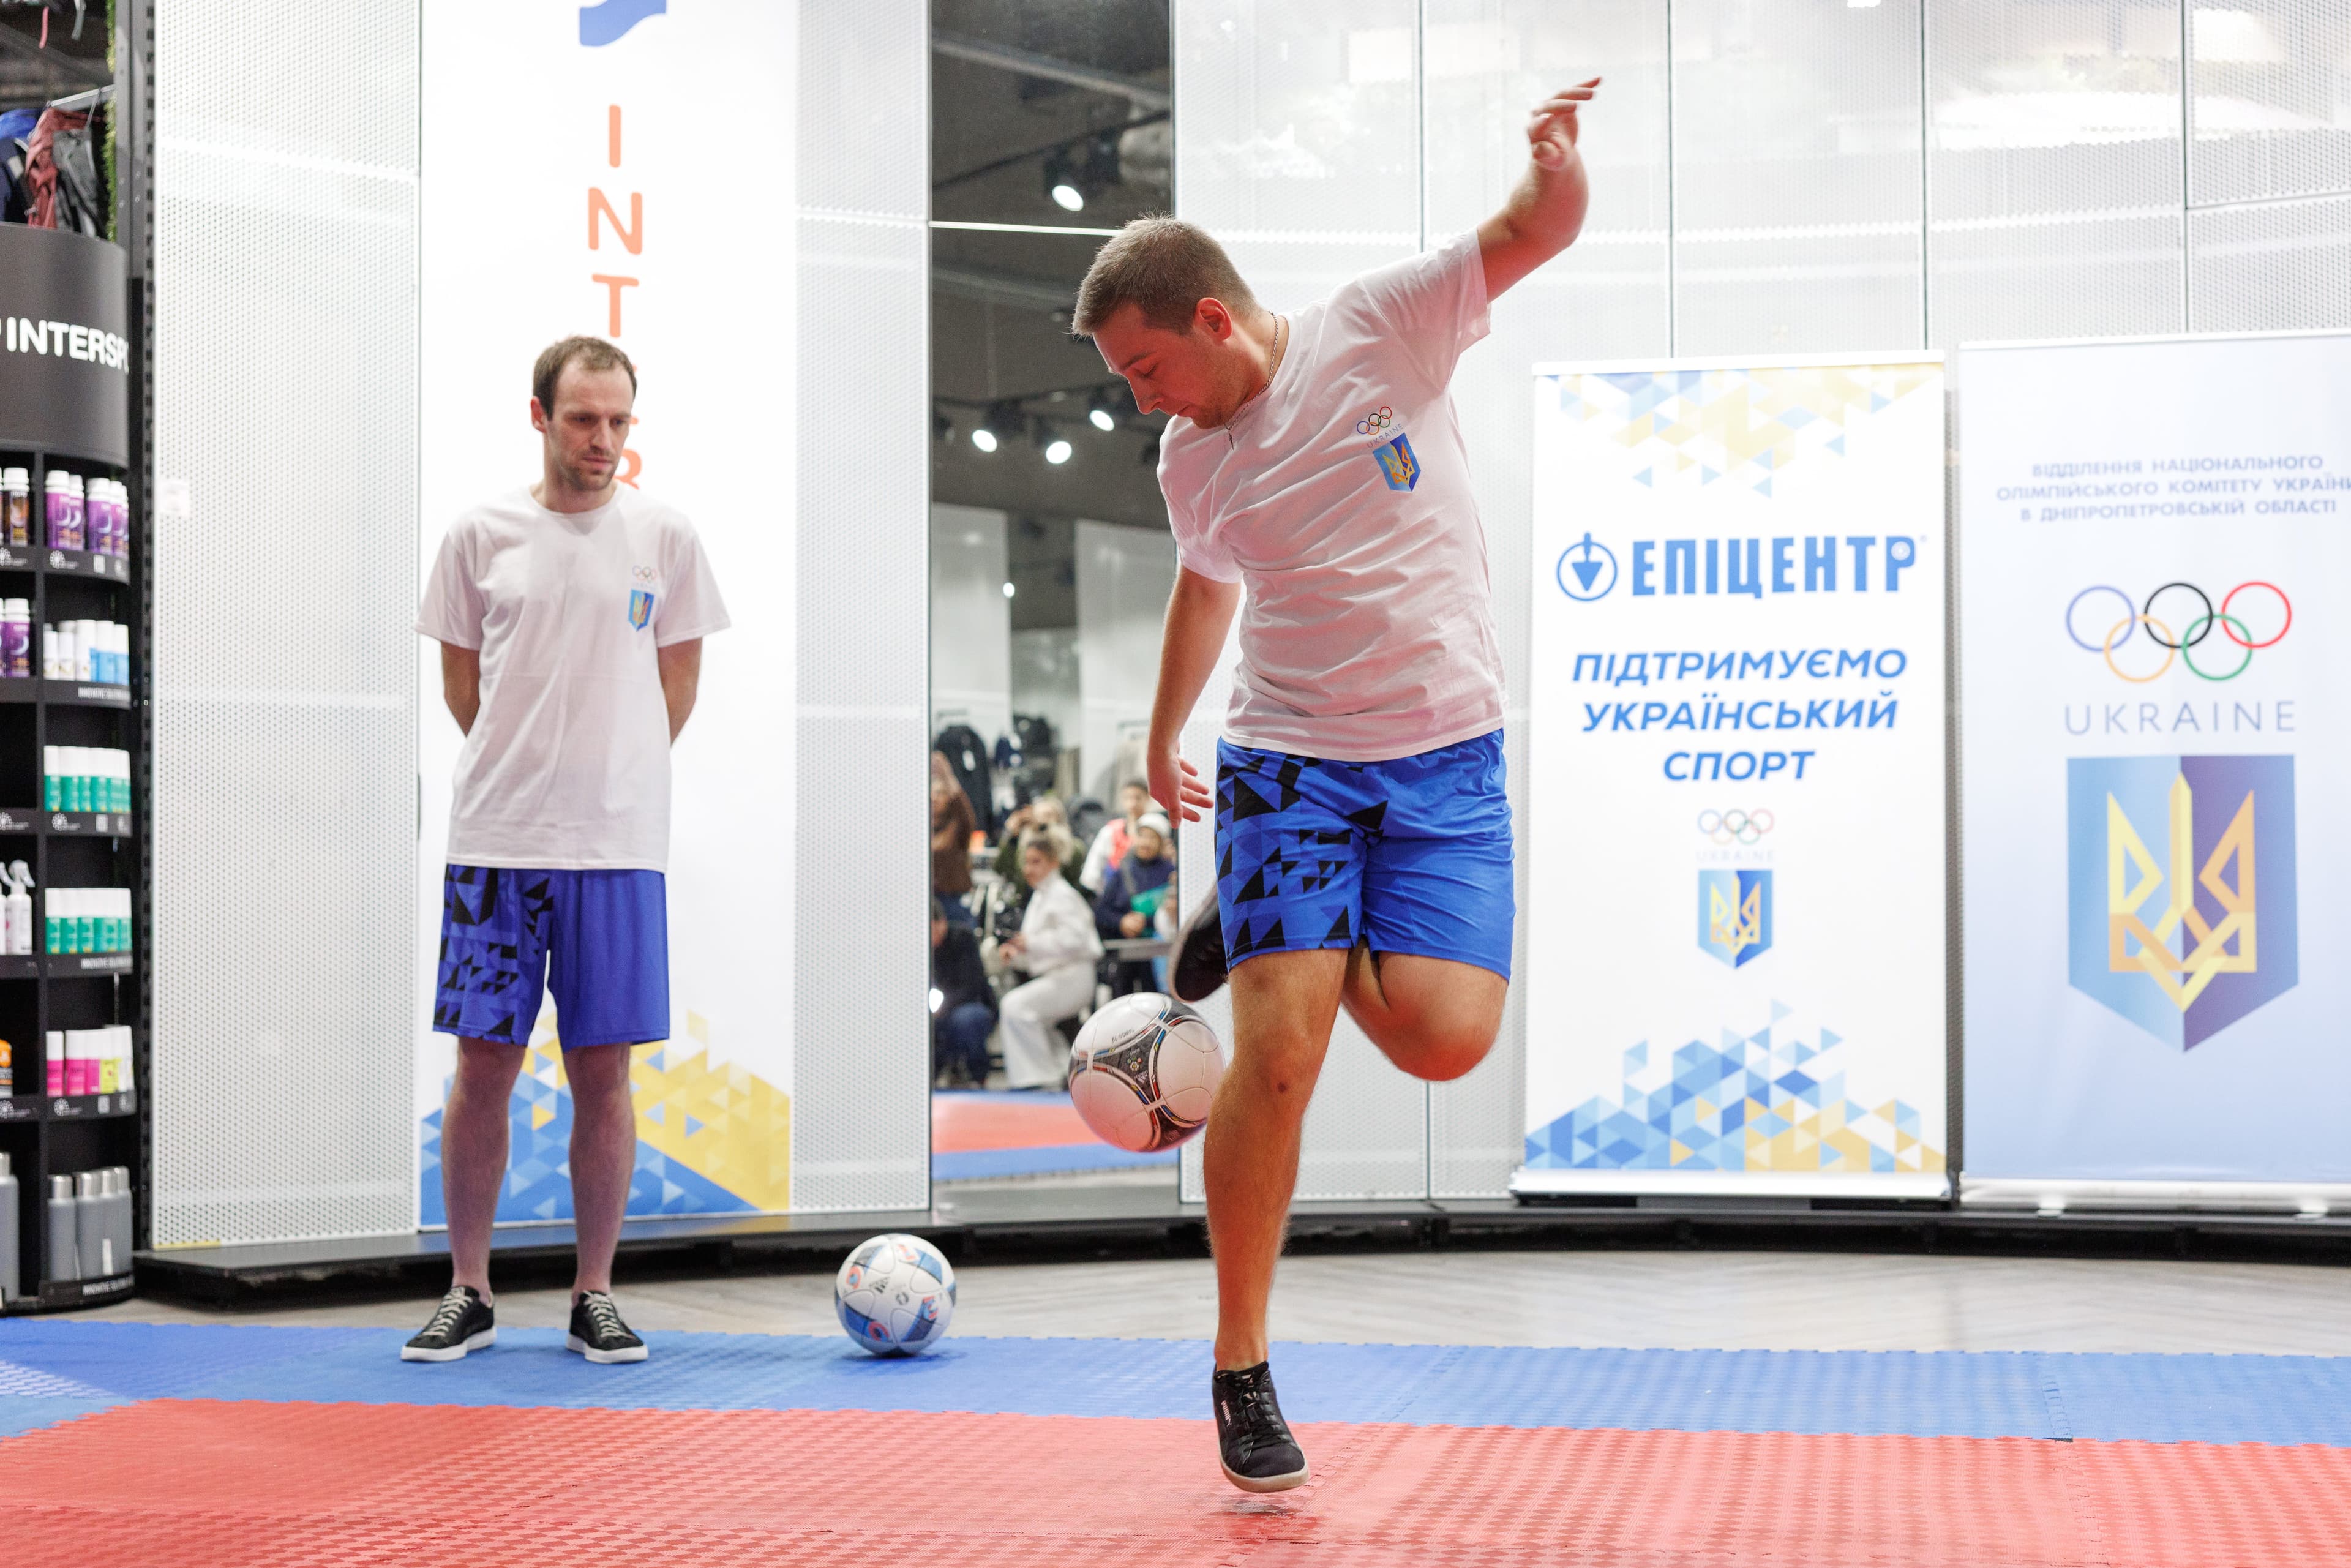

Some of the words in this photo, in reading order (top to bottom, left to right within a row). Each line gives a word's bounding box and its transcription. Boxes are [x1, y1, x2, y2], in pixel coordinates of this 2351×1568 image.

[1367, 423, 1404, 448] UKRAINE
[2031, 460, 2143, 479] ВІДДІЛЕННЯ
[2152, 455, 2323, 473] НАЦІОНАЛЬНОГО
[1997, 481, 2159, 501] ОЛІМПІЙСЬКОГО
[2169, 479, 2263, 493] КОМІТЕТУ
[2020, 508, 2031, 522] В
[2040, 498, 2245, 522] ДНІПРОПЕТРОВСЬКІЙ
[2255, 499, 2338, 515] ОБЛАСТІ
[1632, 536, 1916, 599] ЕПІЦЕНТР
[1572, 650, 1907, 687] ПІДТРИМУЄМО
[1582, 691, 1899, 732] УКРАЇНСЬКИЙ
[2064, 700, 2296, 736] UKRAINE
[1663, 750, 1815, 781] СПОРТ
